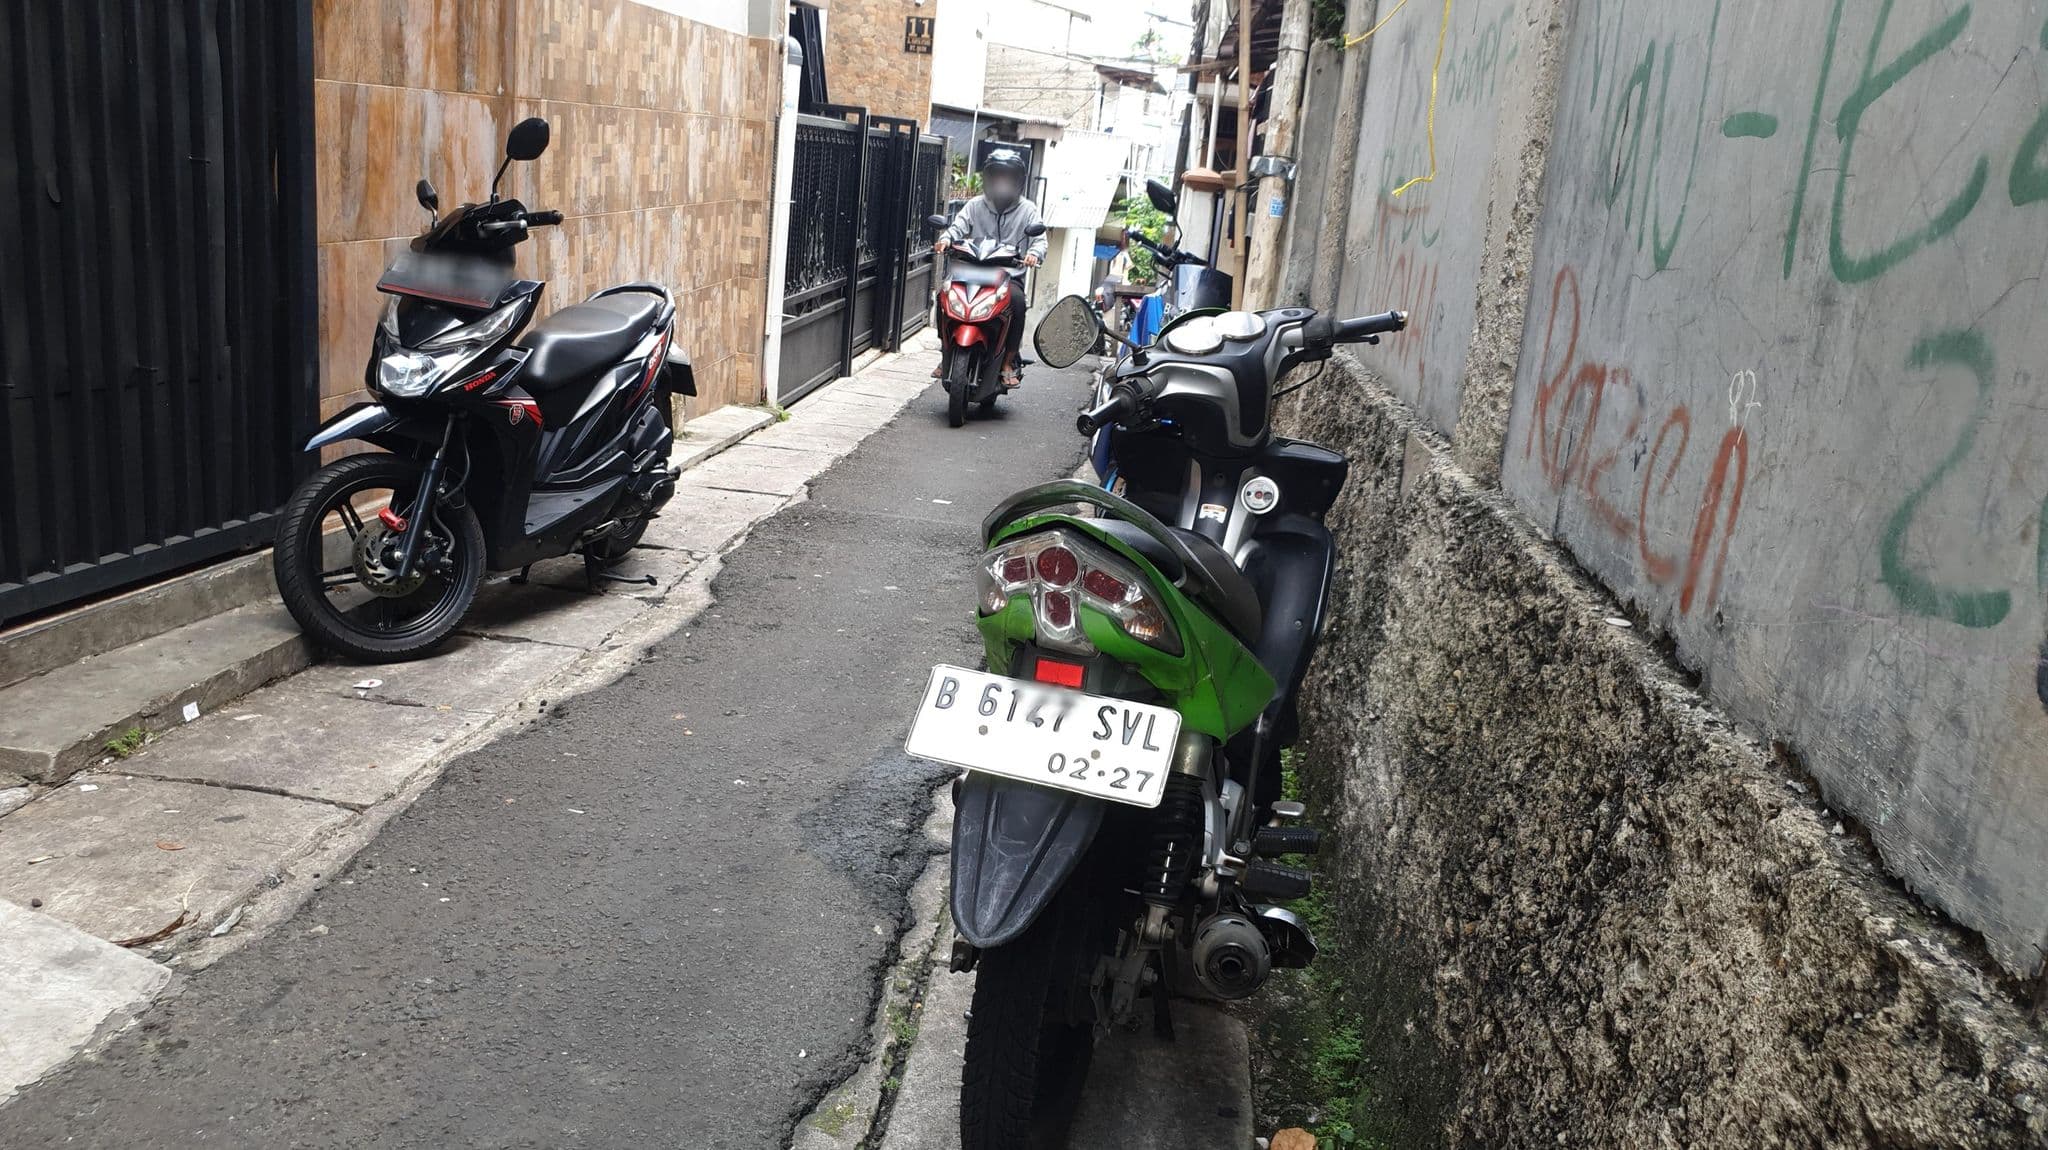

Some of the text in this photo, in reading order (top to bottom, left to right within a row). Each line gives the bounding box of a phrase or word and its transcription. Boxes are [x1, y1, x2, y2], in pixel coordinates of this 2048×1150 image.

[909, 18, 930, 38] 11
[463, 371, 497, 391] HONDA
[935, 676, 959, 709] B
[1093, 705, 1160, 752] SVL
